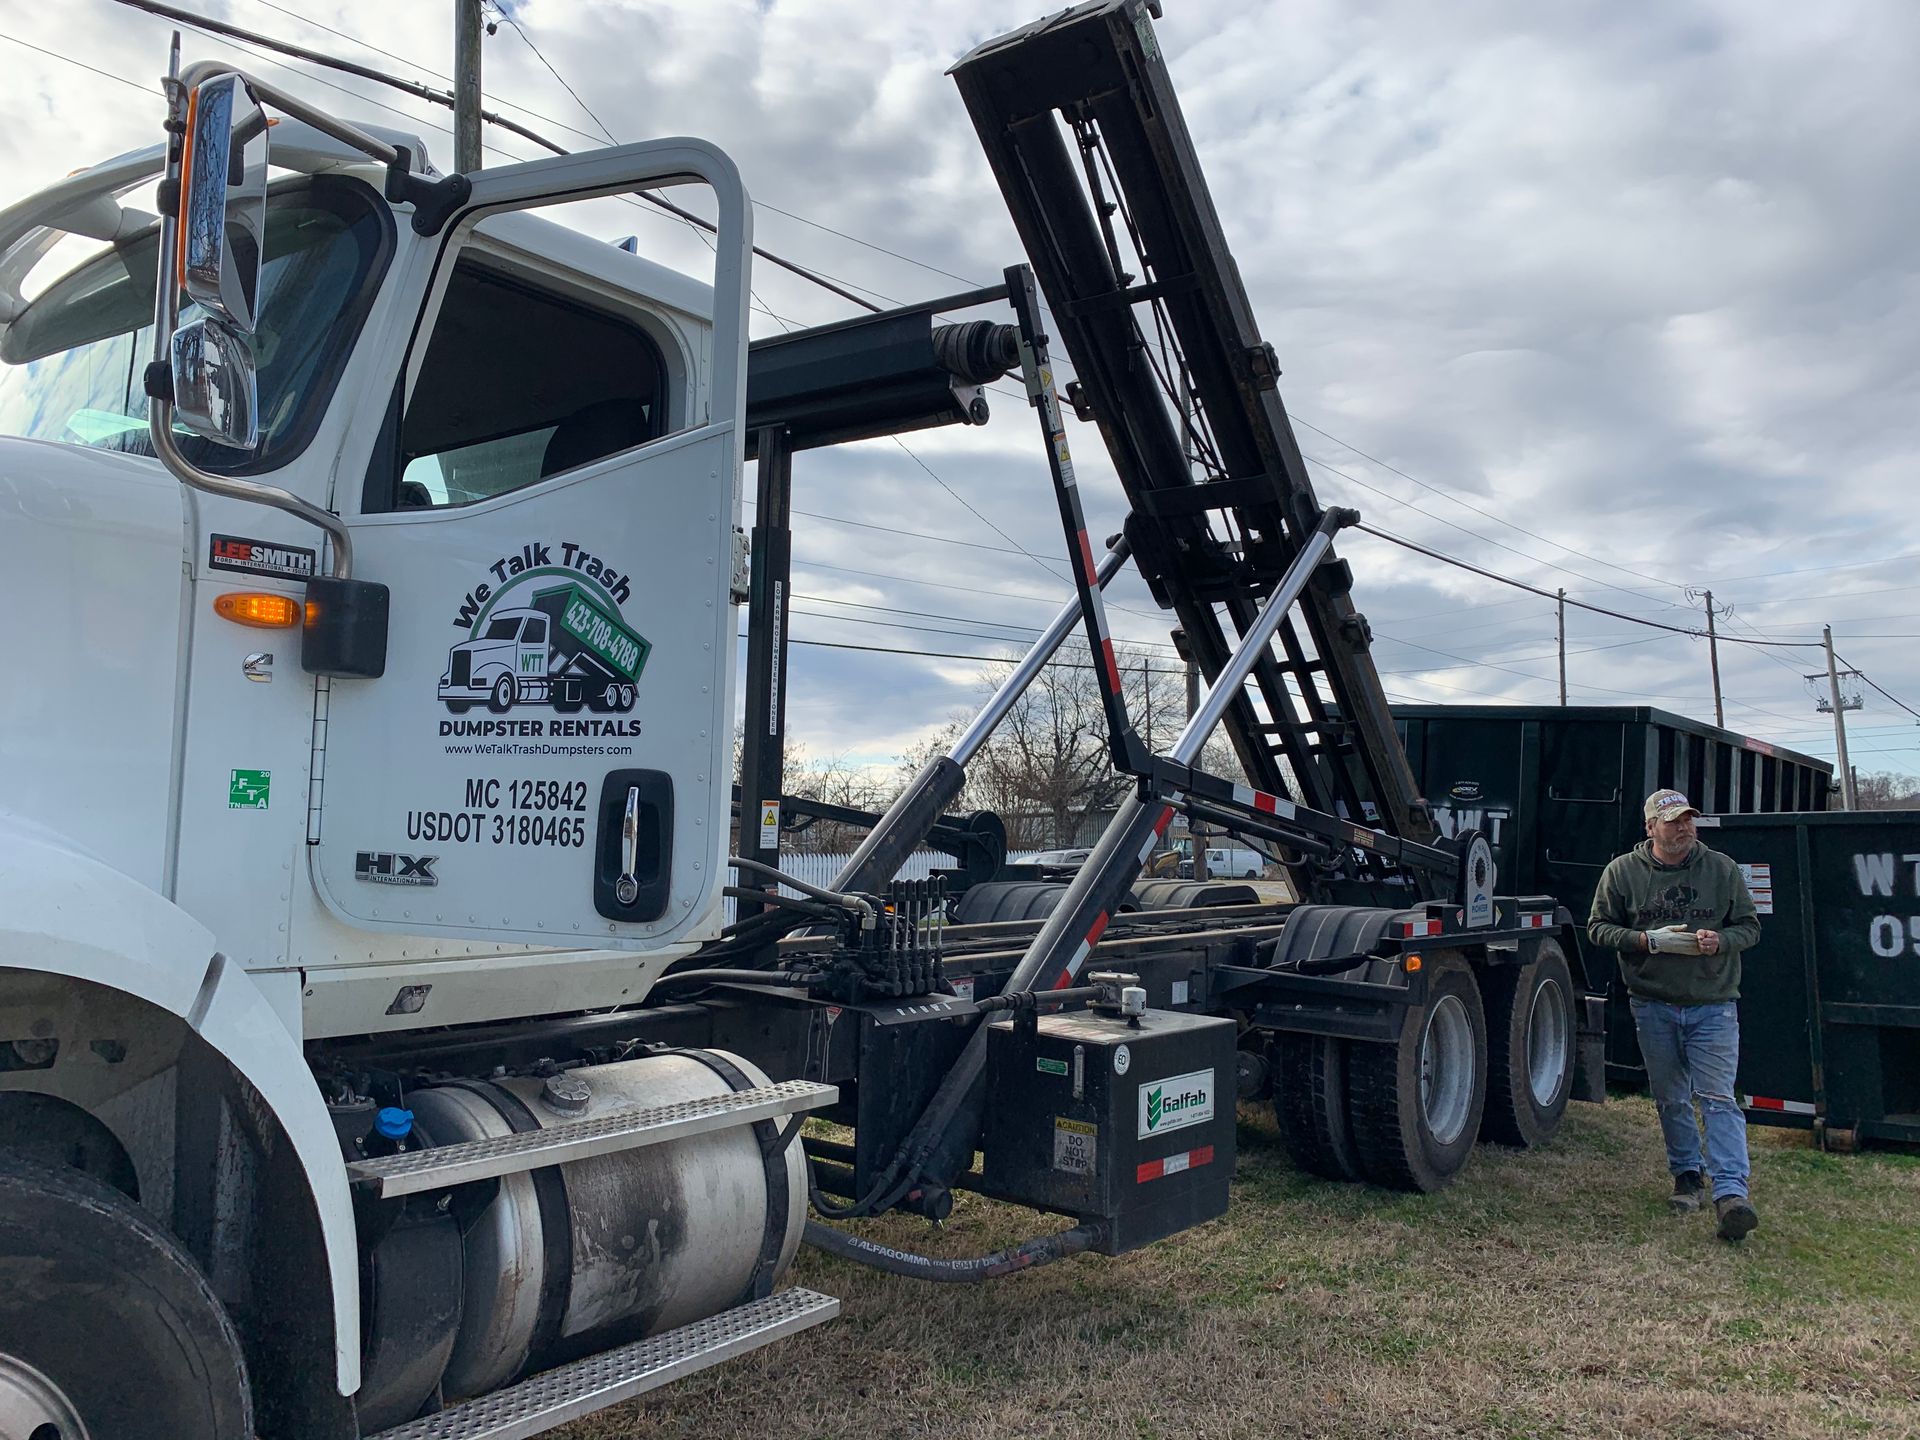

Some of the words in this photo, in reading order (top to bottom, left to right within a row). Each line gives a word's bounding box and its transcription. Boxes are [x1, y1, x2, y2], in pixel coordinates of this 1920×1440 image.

[216, 557, 233, 565] FORD
[240, 560, 285, 572] INTERNATIONAL
[453, 583, 491, 629] We
[489, 542, 552, 584] Talk
[561, 542, 631, 605] Trash
[566, 600, 639, 672] 423-708-4788
[521, 653, 544, 673] WTT
[439, 720, 543, 737] DUMPSTER
[550, 720, 641, 737] RENTALS
[465, 779, 500, 808] MC
[509, 780, 587, 811] 125842
[407, 811, 486, 842] USDOT
[492, 815, 585, 848] 3180465
[356, 853, 436, 877] HX
[370, 876, 419, 884] INTERNATIONAL
[1163, 1089, 1206, 1114] Galfab
[1062, 1121, 1095, 1136] CAUTION
[1065, 1145, 1085, 1158] NOT
[1069, 1135, 1083, 1146] DO
[857, 1241, 931, 1267] ALFAGOMMA
